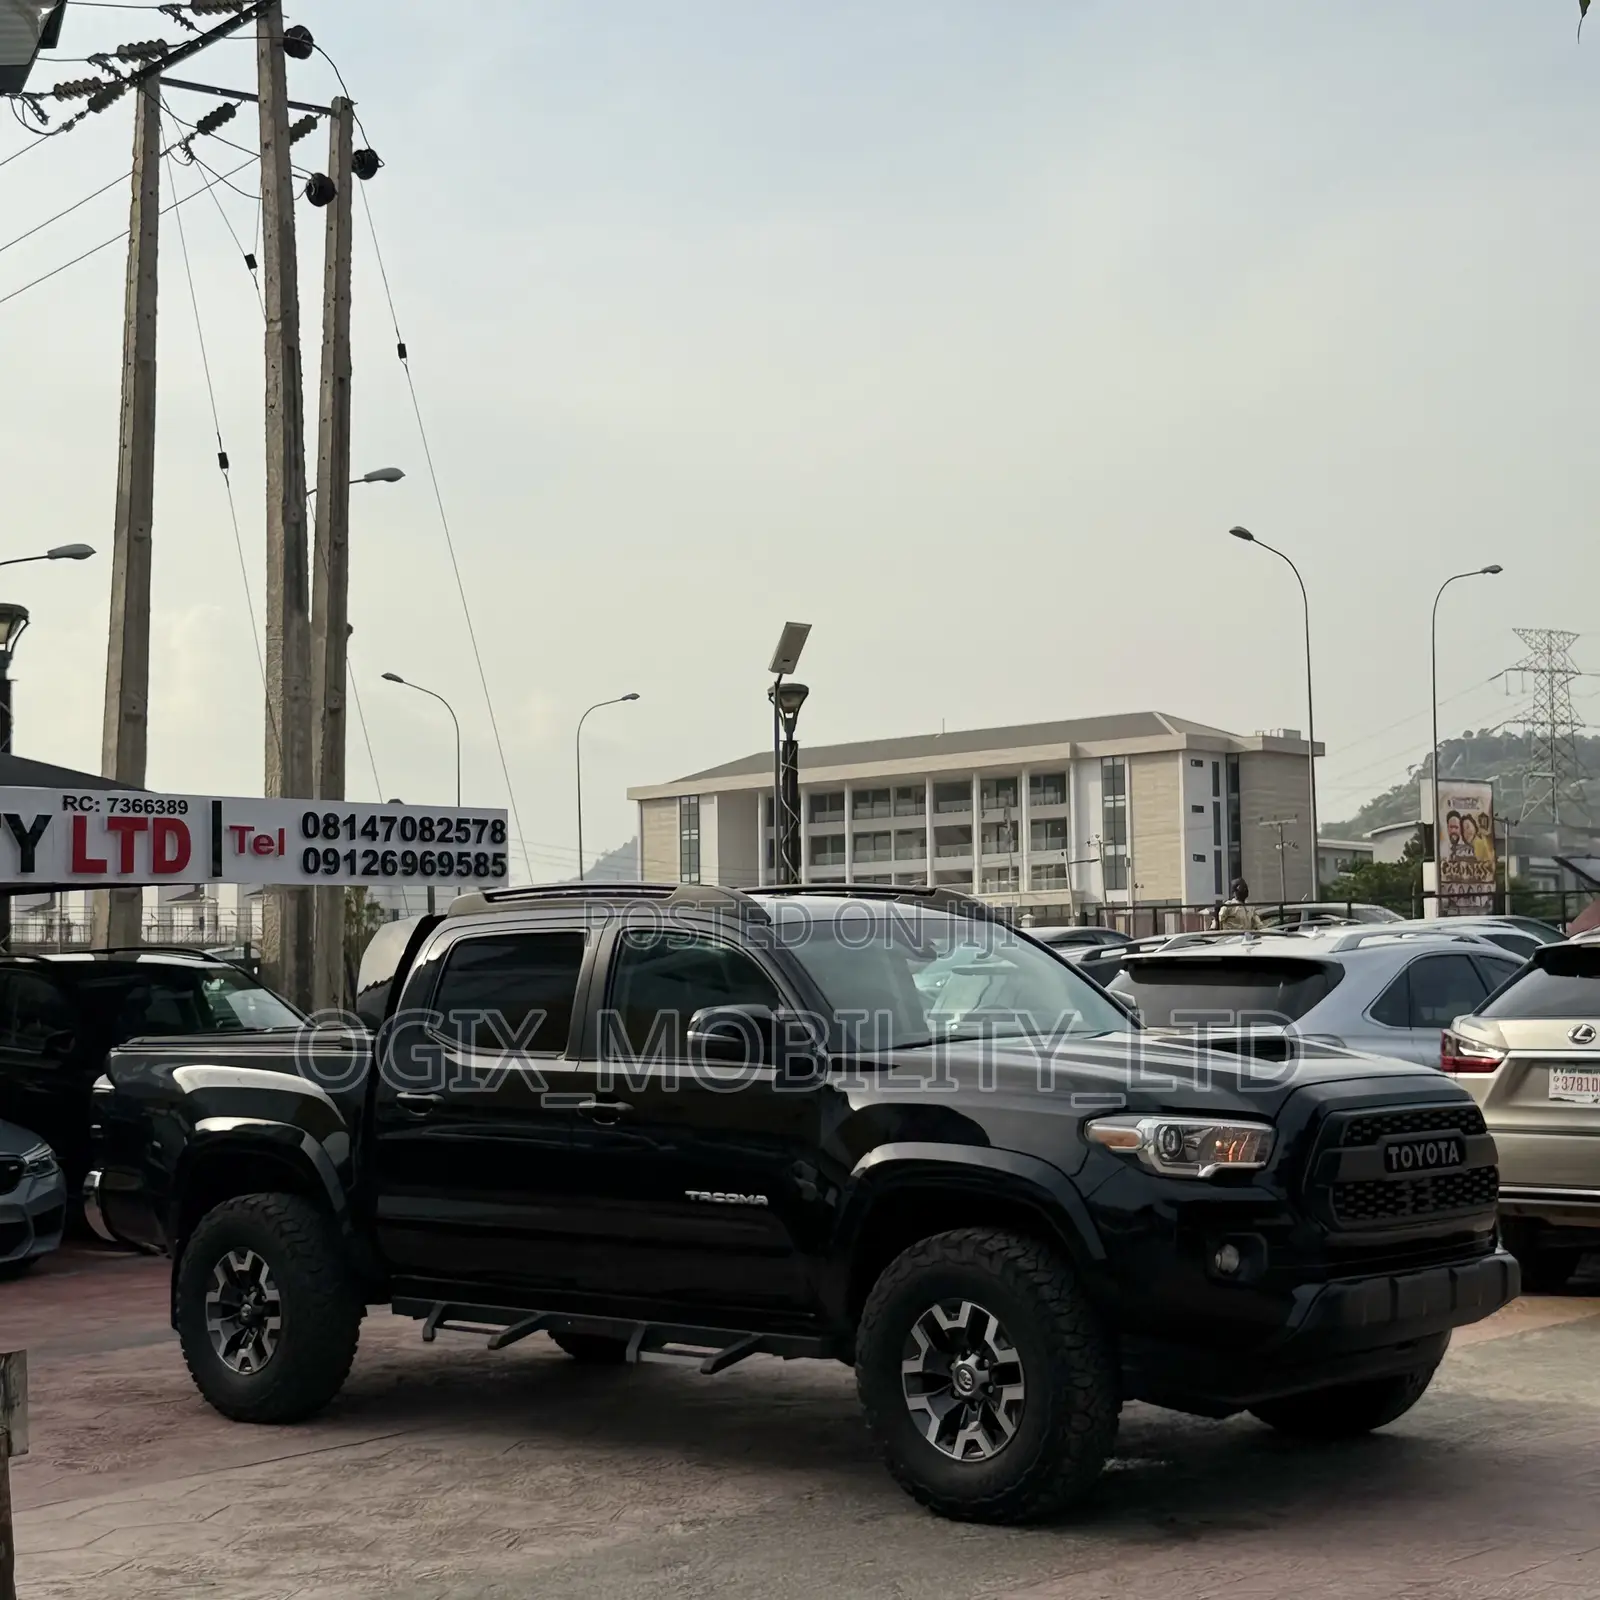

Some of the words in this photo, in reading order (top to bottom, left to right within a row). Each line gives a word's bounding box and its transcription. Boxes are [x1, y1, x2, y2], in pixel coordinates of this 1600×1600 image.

[62, 795, 101, 812] RC:
[107, 797, 188, 815] 7366389
[229, 825, 286, 856] Tel
[302, 811, 507, 844] 08147082578
[0, 813, 53, 873] Y
[72, 815, 192, 874] LTD
[302, 847, 507, 877] 09126969585
[1388, 1141, 1459, 1170] TOYOTA
[685, 1190, 769, 1205] TACOMA
